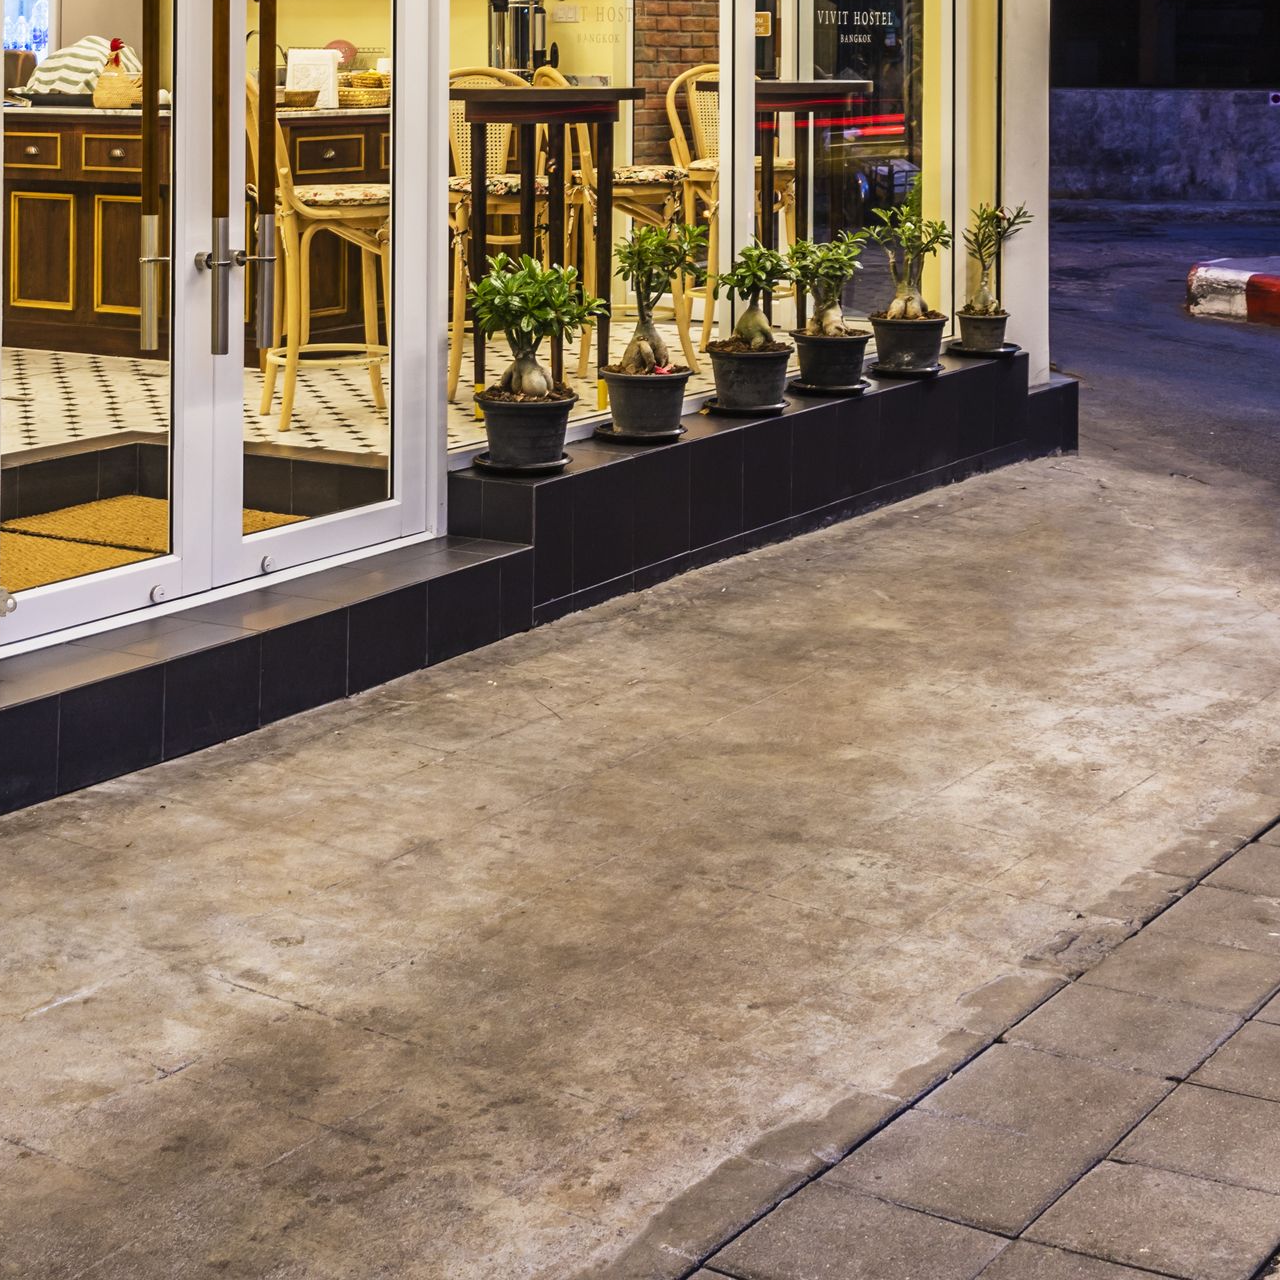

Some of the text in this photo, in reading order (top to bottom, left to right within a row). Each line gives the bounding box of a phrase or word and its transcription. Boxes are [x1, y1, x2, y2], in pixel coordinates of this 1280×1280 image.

[817, 10, 893, 26] VIVIT HOSTEL
[840, 34, 872, 43] BANGKOK
